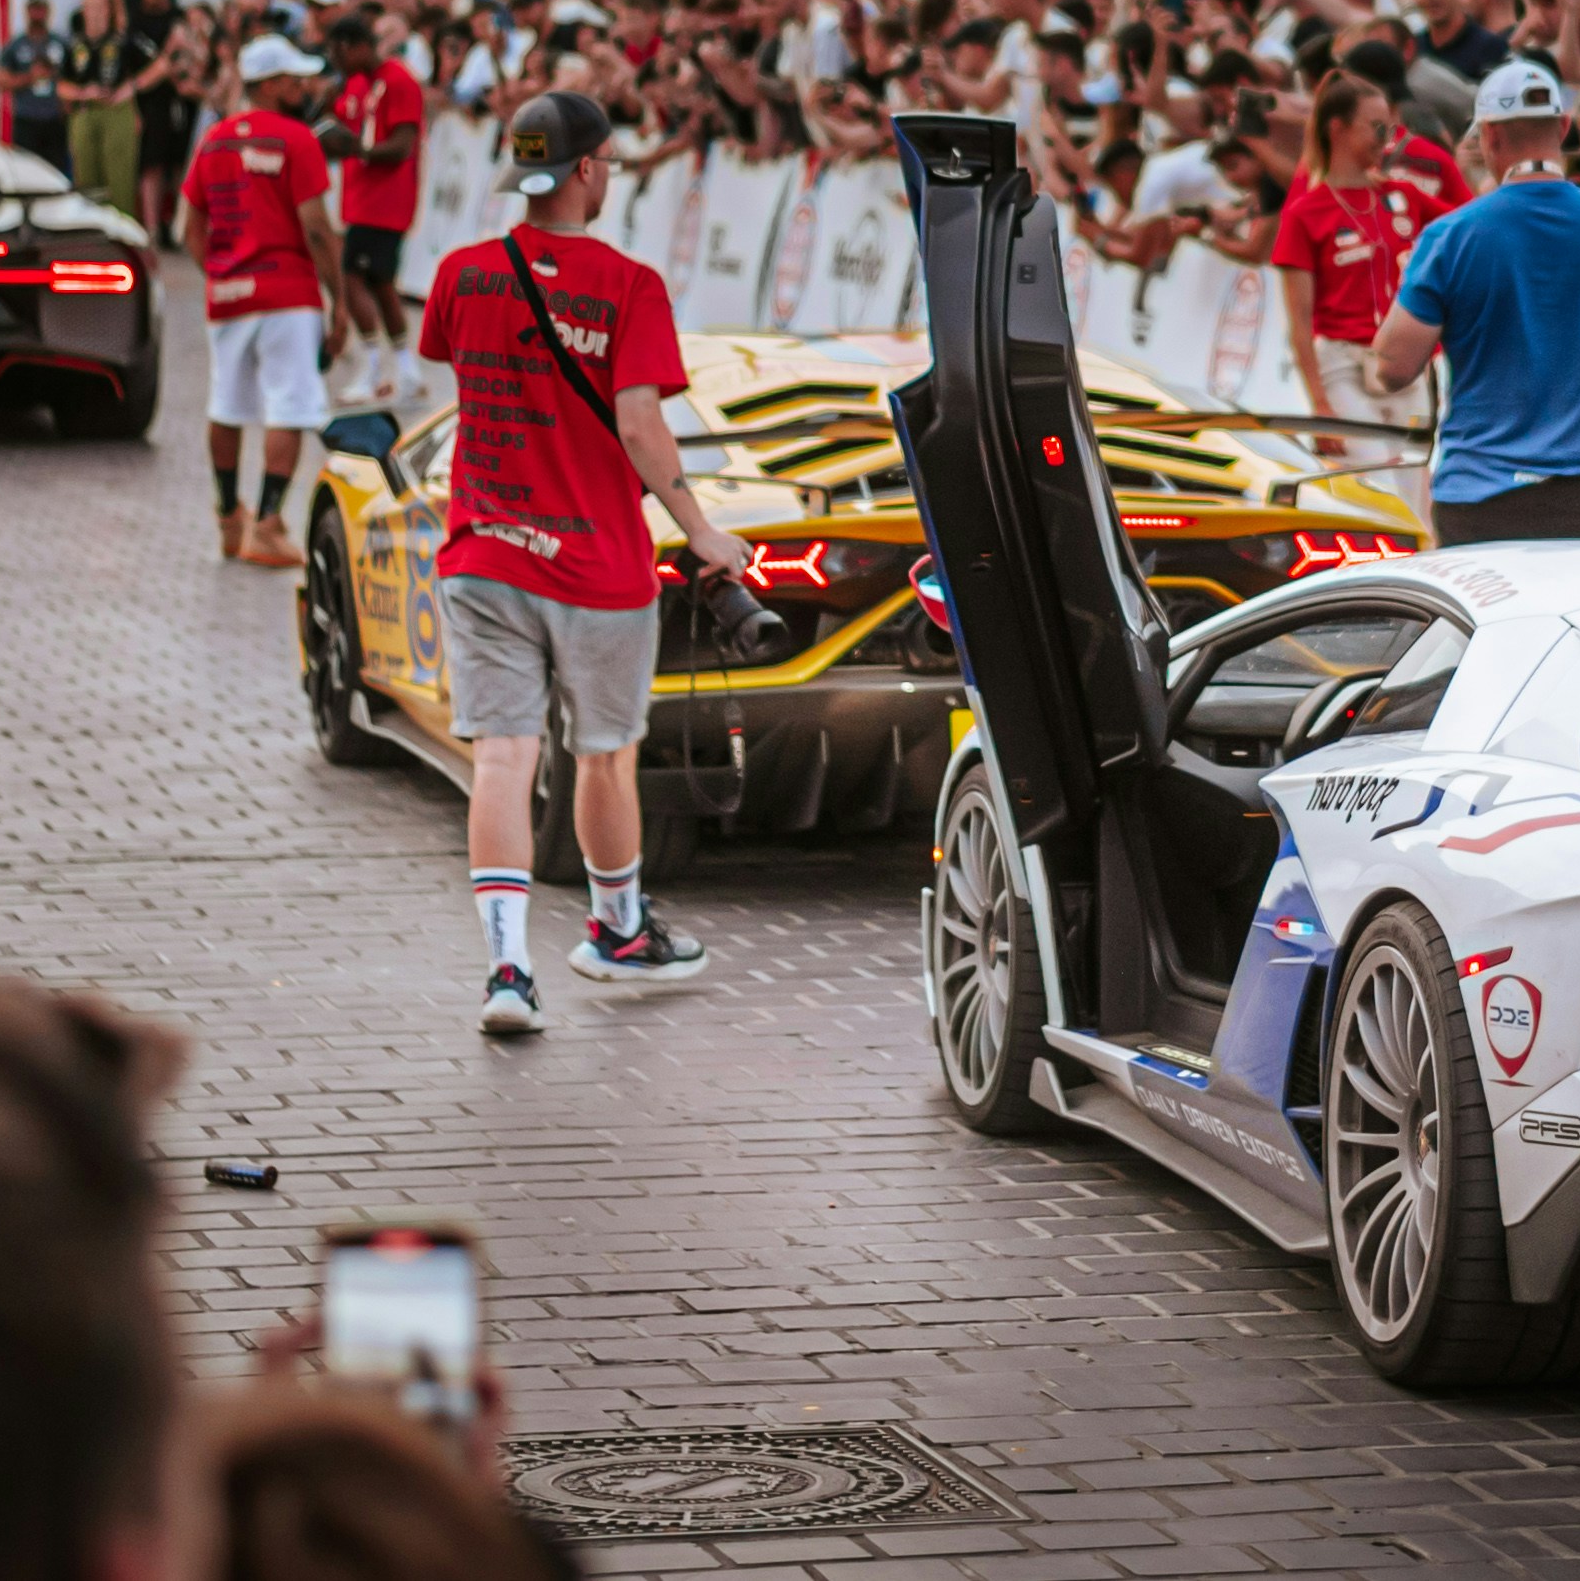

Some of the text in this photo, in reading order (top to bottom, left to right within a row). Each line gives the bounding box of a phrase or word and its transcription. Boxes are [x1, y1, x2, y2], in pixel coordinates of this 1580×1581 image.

[548, 313, 610, 358] our
[1452, 568, 1520, 608] 3000
[1489, 1005, 1530, 1027] DDE
[1135, 1085, 1306, 1183] DAILY DRIVEN EXOTICS
